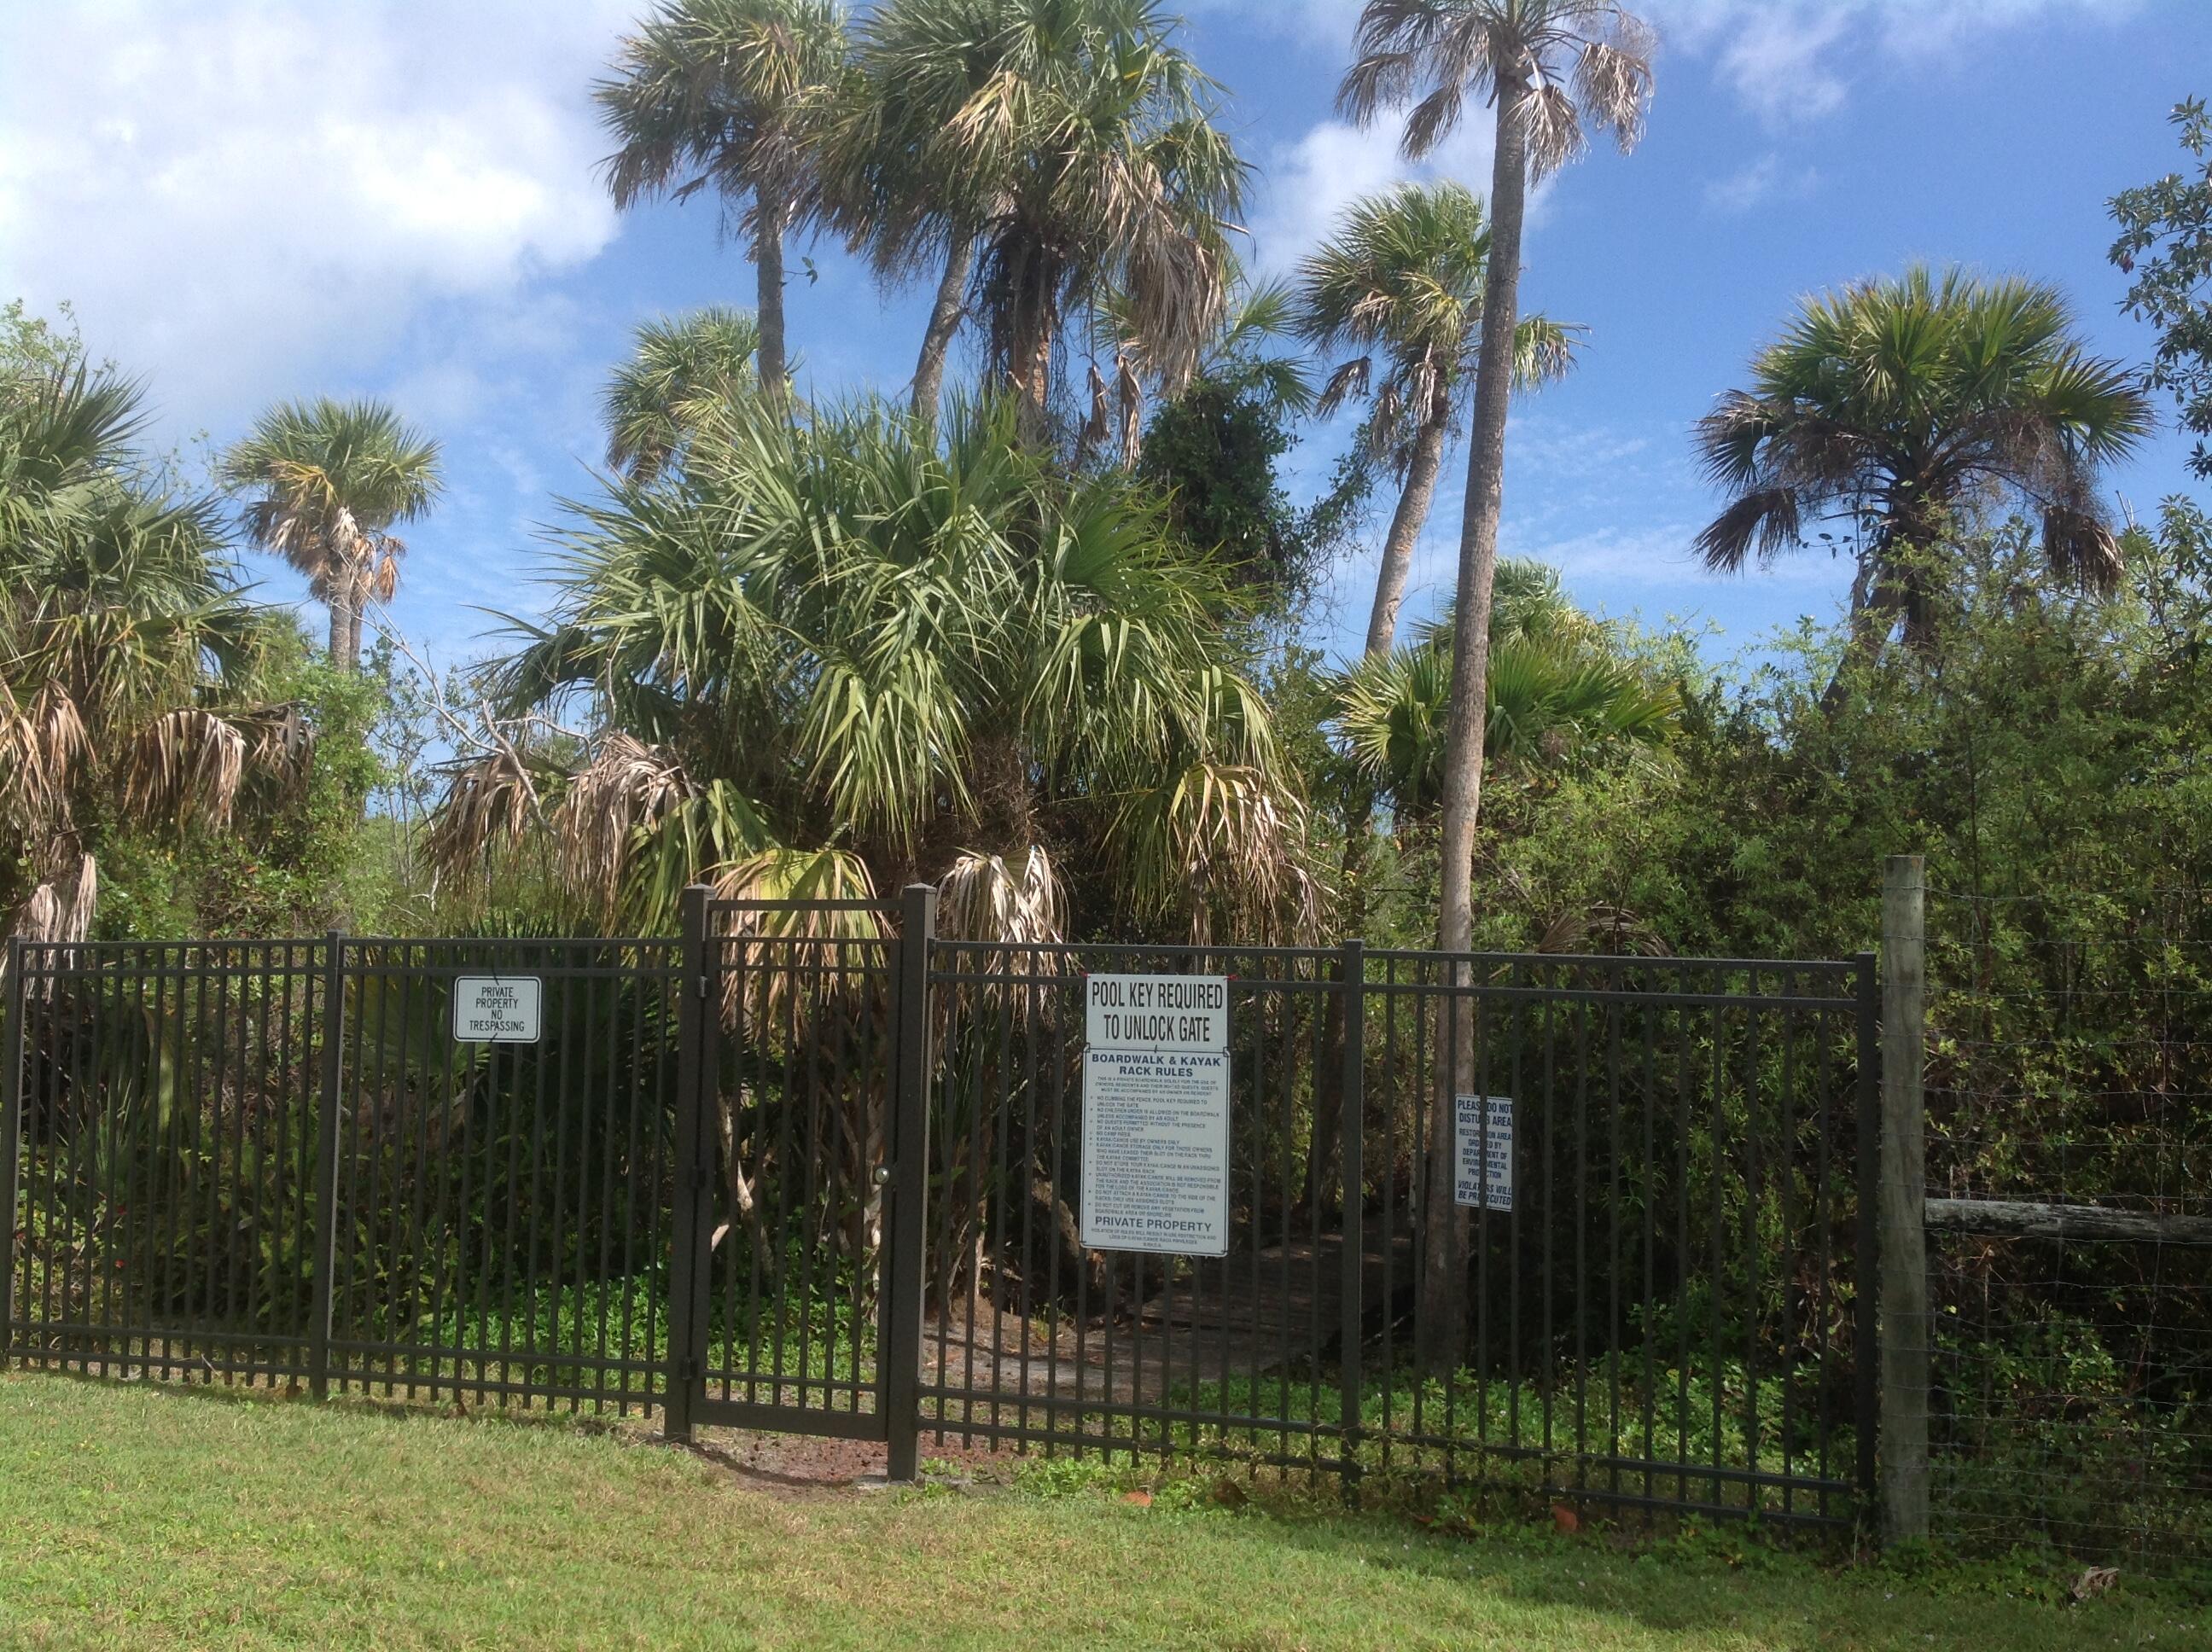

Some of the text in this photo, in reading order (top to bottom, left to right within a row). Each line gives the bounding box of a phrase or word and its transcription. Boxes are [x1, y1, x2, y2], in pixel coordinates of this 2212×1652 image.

[481, 987, 514, 998] PRIVATE
[1091, 981, 1223, 1010] POOL KEY REQUIRED
[475, 998, 519, 1009] PROPERTY
[491, 1009, 503, 1020] NO
[469, 1021, 525, 1032] TRESPASSING
[1103, 1015, 1210, 1042] TO UNLOCK GATE
[1091, 1054, 1221, 1067] BOARDWALK & KAYAK
[1119, 1067, 1193, 1077] RACK RULES
[1458, 1100, 1481, 1111] PLEAS
[1493, 1116, 1511, 1126] AREA
[1458, 1190, 1467, 1199] BE
[1496, 1185, 1511, 1195] WILL
[1095, 1216, 1212, 1232] PRIVATE PROPERTY
